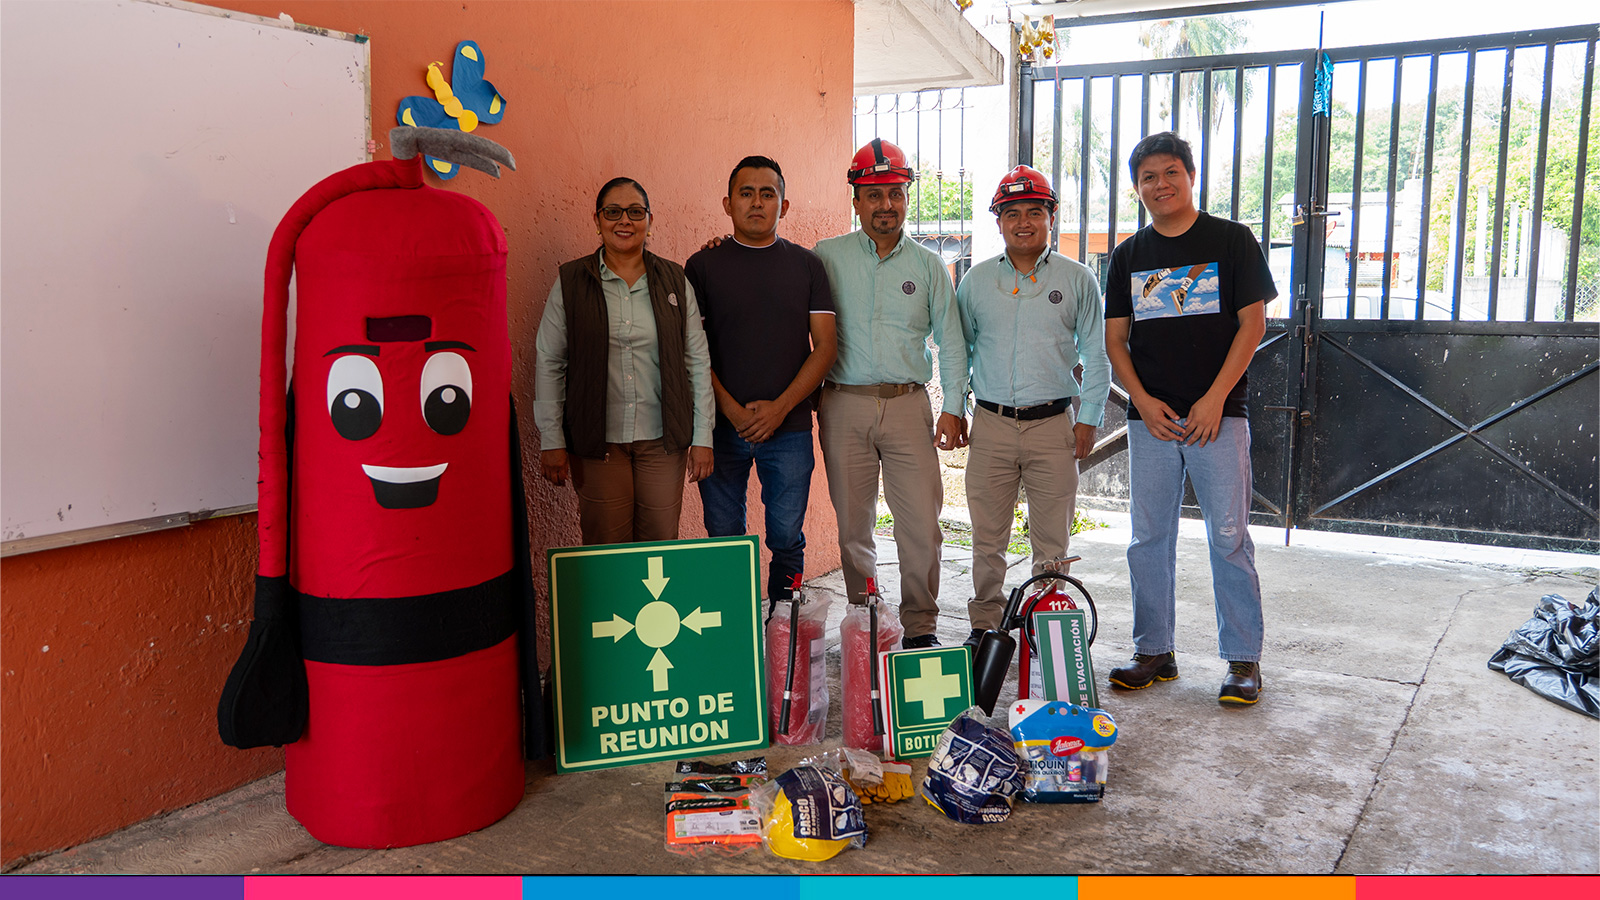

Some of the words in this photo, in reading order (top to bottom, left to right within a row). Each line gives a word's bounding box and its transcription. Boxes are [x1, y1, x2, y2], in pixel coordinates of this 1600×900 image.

[1048, 601, 1070, 611] 112
[1070, 619, 1087, 691] EVACUACIÓN
[592, 697, 689, 727] PUNTO
[699, 692, 734, 715] DE
[1080, 694, 1089, 708] DE
[600, 719, 729, 754] REUNION
[796, 798, 811, 836] CASCO
